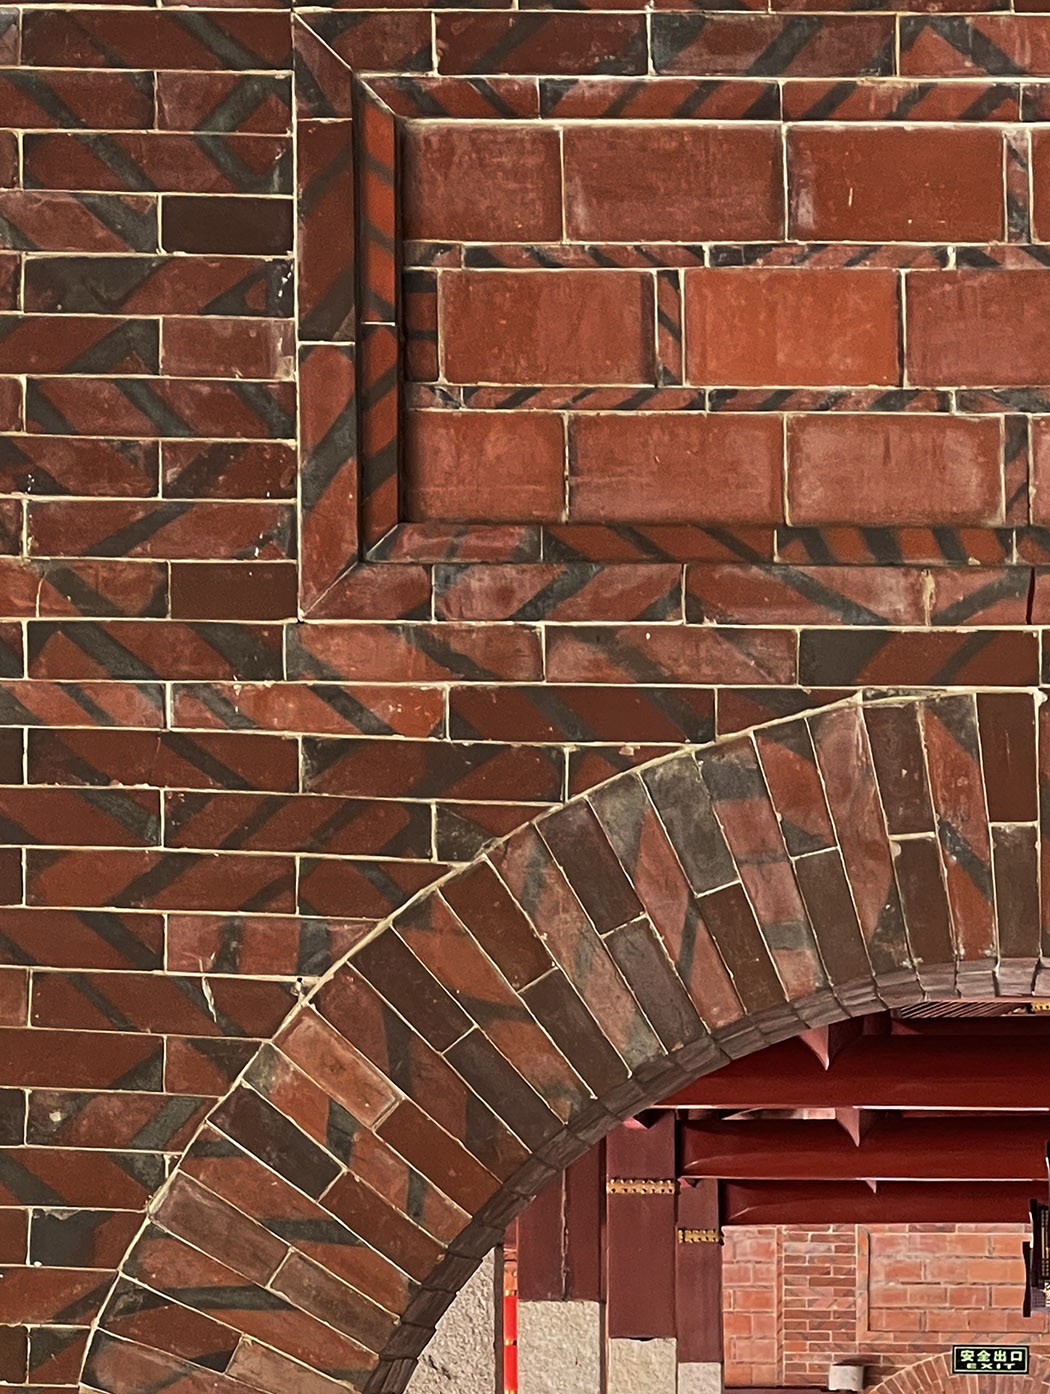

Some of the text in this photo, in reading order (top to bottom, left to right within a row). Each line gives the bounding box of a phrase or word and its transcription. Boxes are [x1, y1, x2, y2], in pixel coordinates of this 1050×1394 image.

[960, 1350, 1023, 1362] 安全出口
[966, 1362, 1016, 1370] EXIT
